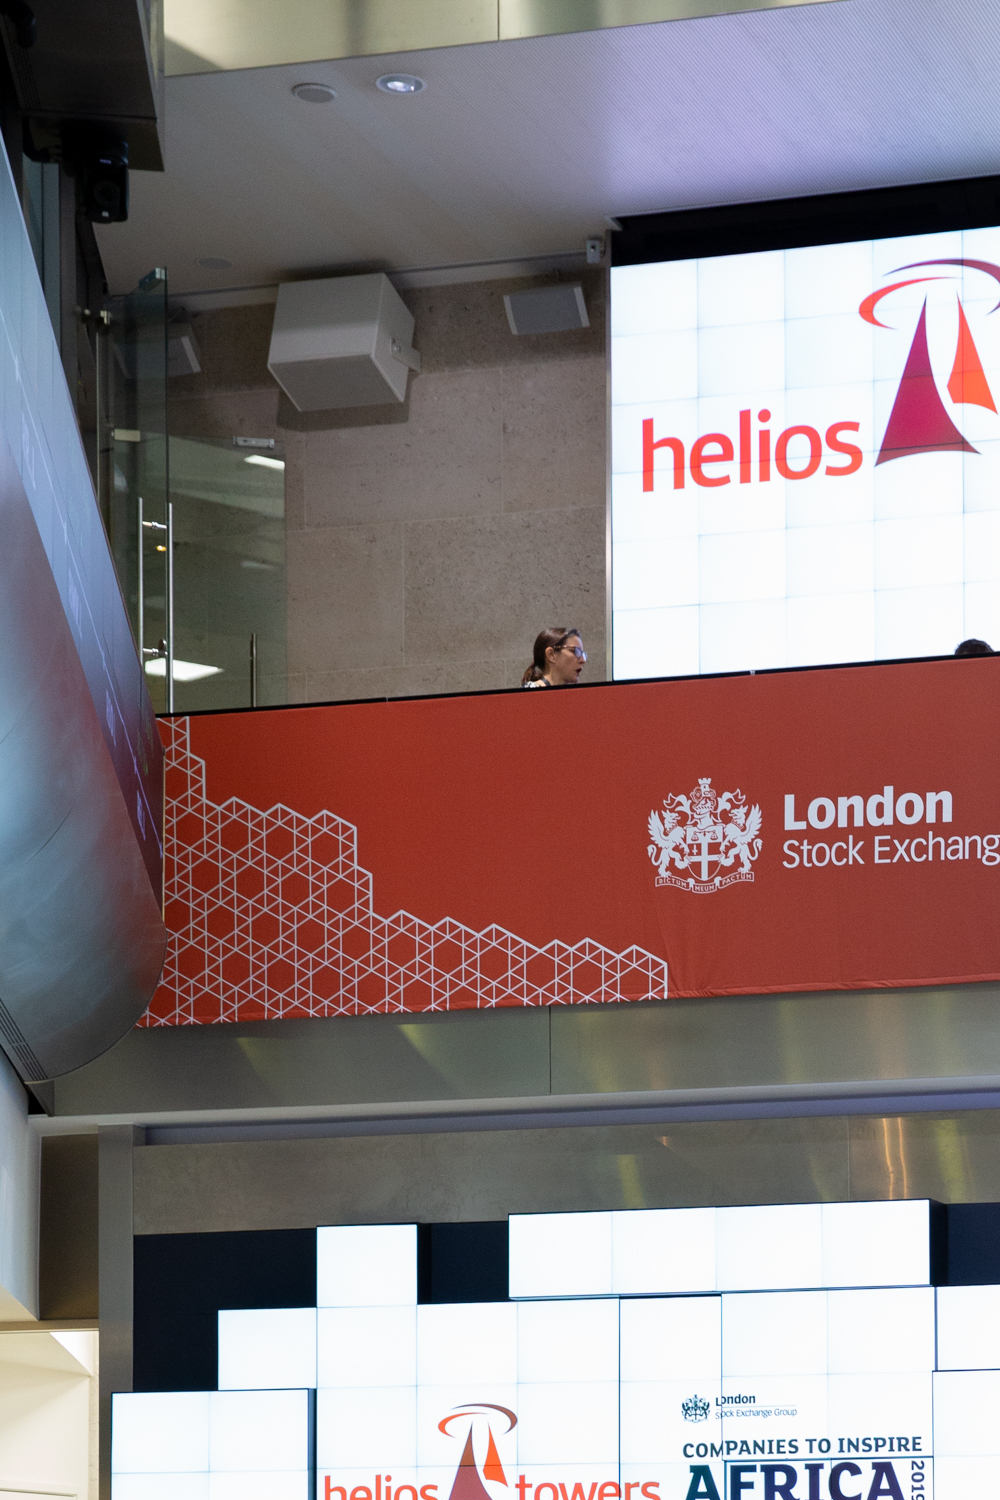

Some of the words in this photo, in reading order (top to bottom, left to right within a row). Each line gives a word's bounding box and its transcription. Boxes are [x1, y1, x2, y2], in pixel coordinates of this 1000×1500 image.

[642, 408, 863, 493] helios
[784, 785, 953, 831] London
[782, 835, 865, 868] Stock
[658, 875, 688, 888] DICTUM
[694, 884, 715, 892] MEUM
[721, 873, 752, 886] PACTUM
[715, 1393, 756, 1407] London
[715, 1409, 735, 1420] Sock
[736, 1408, 773, 1419] Exchange
[773, 1407, 798, 1417] Group
[682, 1438, 799, 1459] COMPANIES
[805, 1436, 831, 1454] TO
[837, 1435, 923, 1454] INSPIRE
